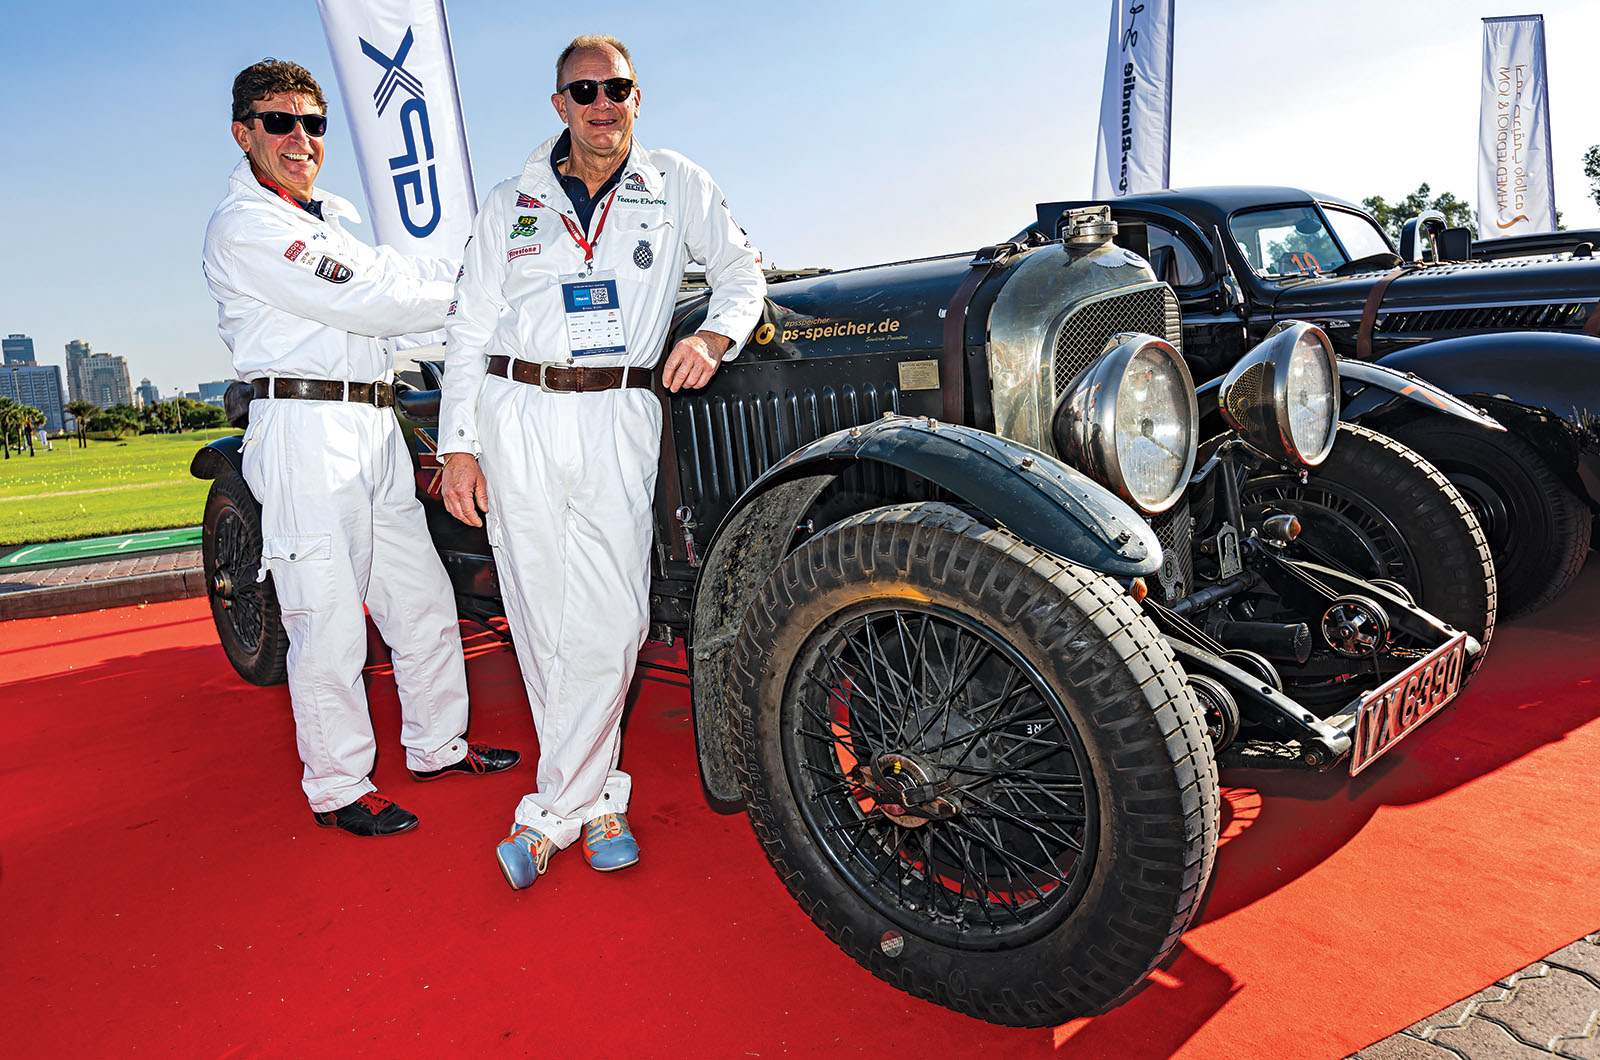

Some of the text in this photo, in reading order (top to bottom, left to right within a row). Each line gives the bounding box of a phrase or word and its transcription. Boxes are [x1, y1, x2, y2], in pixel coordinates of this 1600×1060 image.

[358, 25, 441, 239] GPX
[617, 195, 640, 204] Team
[520, 217, 536, 225] BP
[286, 242, 300, 257] 1000
[509, 246, 537, 258] Firestone
[1290, 252, 1321, 275] 10
[781, 317, 900, 344] ps-speicher.de
